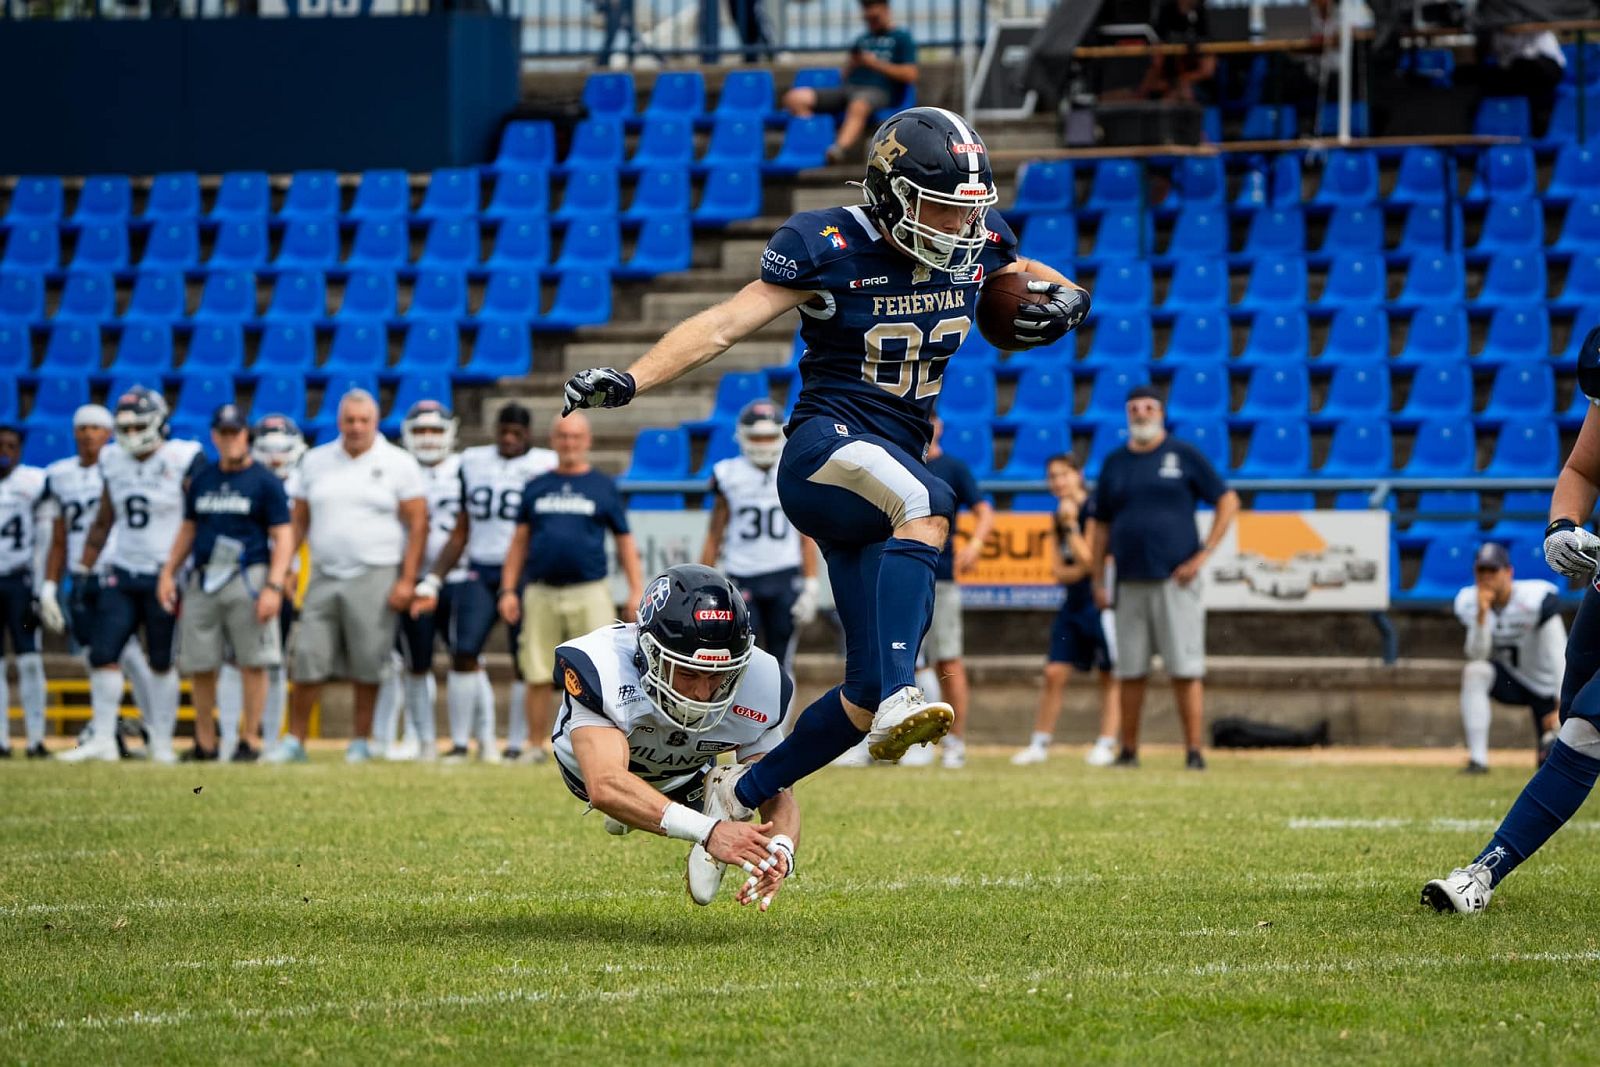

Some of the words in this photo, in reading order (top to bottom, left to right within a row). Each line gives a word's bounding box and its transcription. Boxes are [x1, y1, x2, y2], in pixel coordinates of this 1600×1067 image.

[957, 144, 984, 153] GAZI
[763, 246, 798, 270] KODA
[126, 495, 149, 529] 6
[472, 486, 524, 521] 98
[738, 506, 788, 540] 30
[700, 610, 731, 620] GAZI
[736, 706, 765, 722] GAZI
